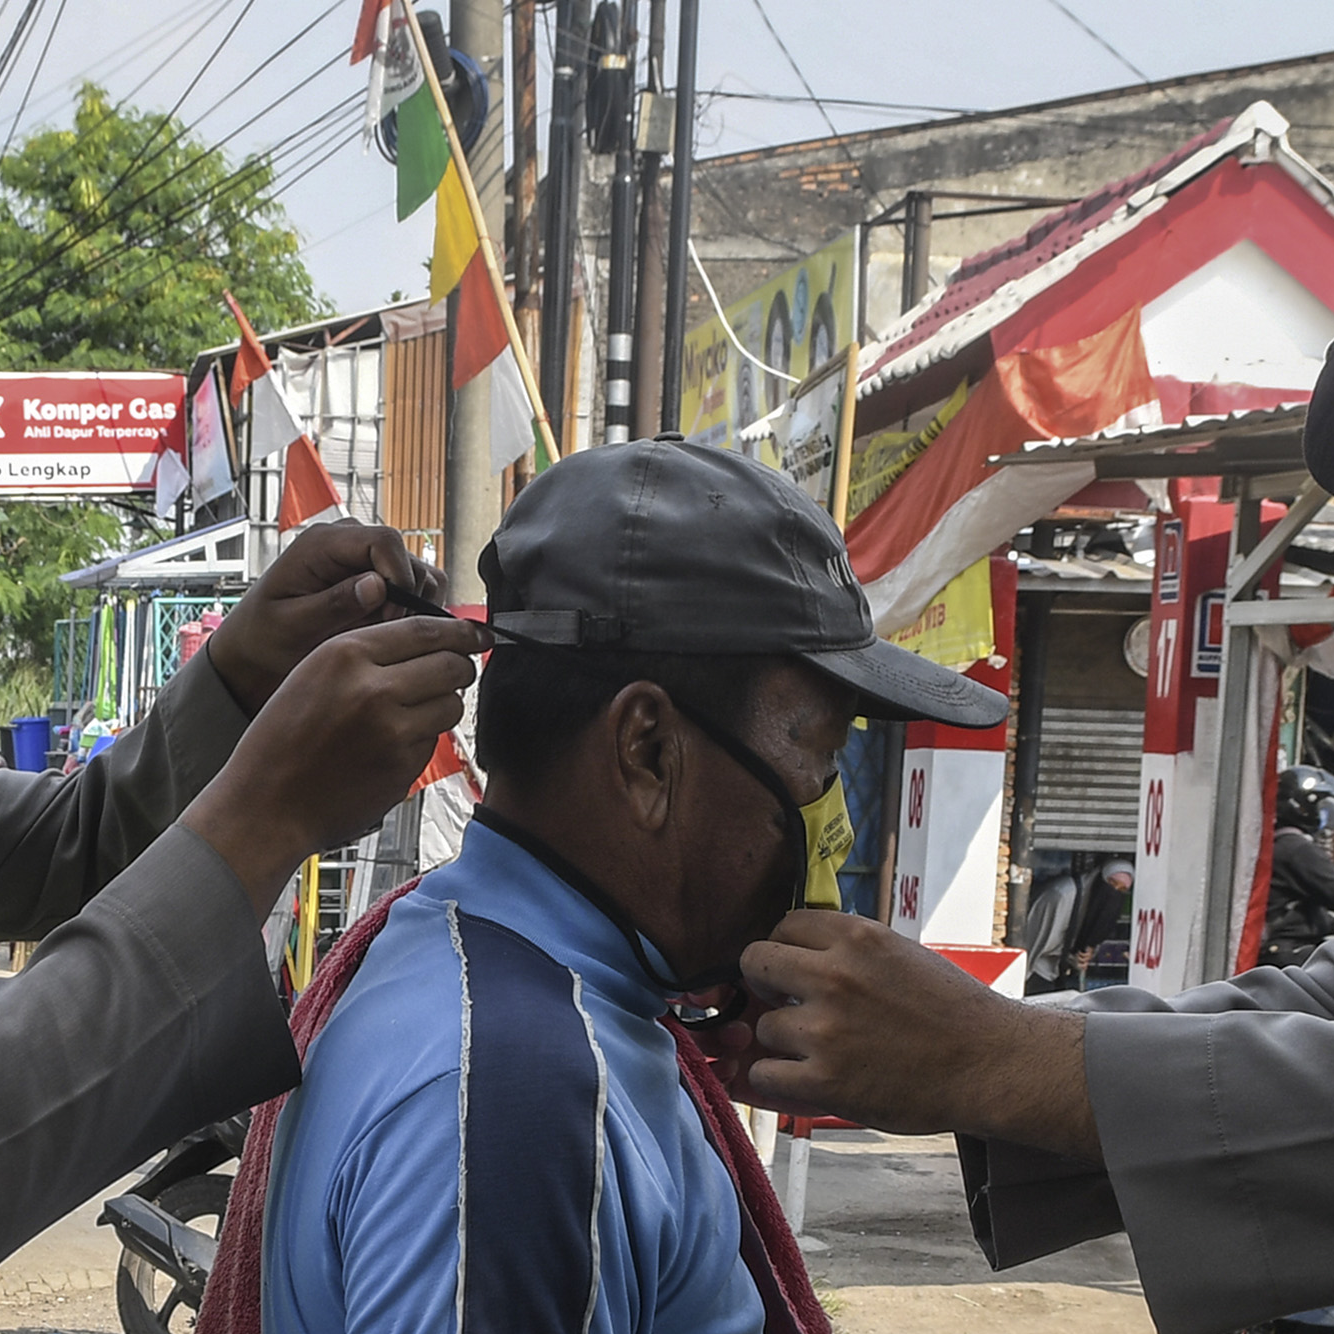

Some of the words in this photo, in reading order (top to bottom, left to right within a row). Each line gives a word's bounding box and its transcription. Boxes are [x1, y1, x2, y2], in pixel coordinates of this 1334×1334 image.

[22, 398, 123, 425] Kompor
[129, 397, 177, 420] Gas
[23, 425, 52, 438] Ahli
[53, 425, 94, 440] Dapur
[9, 462, 91, 481] Lengkap
[1157, 618, 1178, 698] 17
[908, 768, 925, 829] 08
[1145, 779, 1164, 857] 08
[899, 873, 920, 920] 1945
[1134, 908, 1165, 970] 2020
